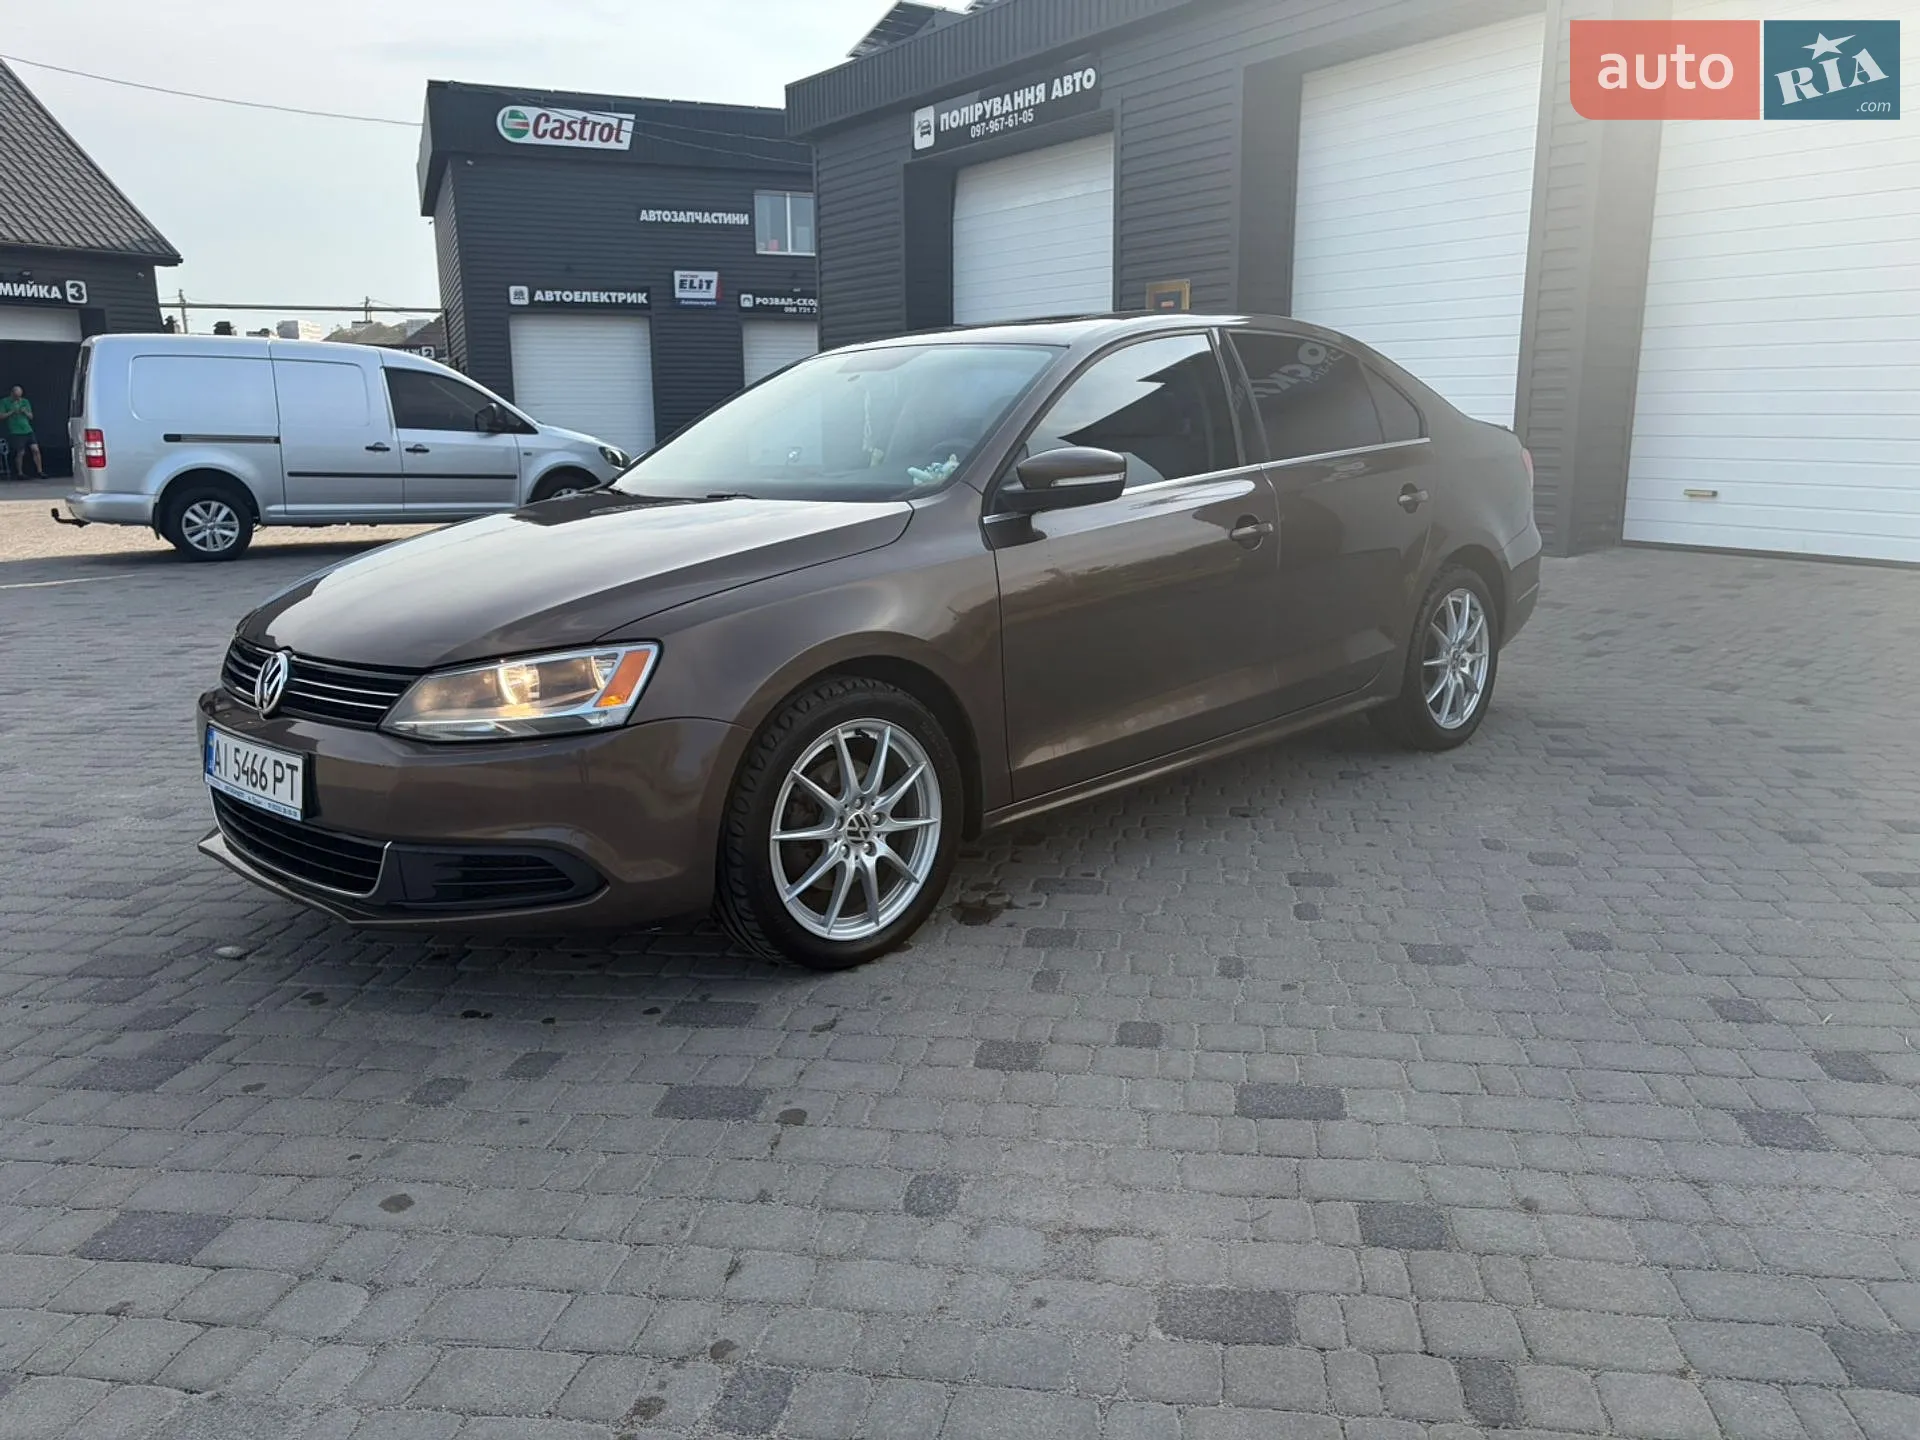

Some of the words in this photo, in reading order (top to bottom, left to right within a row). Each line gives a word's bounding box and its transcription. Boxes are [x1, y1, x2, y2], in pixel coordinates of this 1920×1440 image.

[940, 83, 1046, 132] ПОЛІРУВАННЯ
[1051, 67, 1096, 100] АВТО
[532, 113, 624, 143] Castrol
[640, 209, 749, 225] АВТОЗАПЧАСТИНИ
[0, 280, 62, 299] МИЙКА
[534, 289, 649, 304] АВТОЕЛЕКТРИК
[214, 739, 228, 778] AI
[233, 747, 268, 791] 5466
[273, 759, 299, 802] PT
